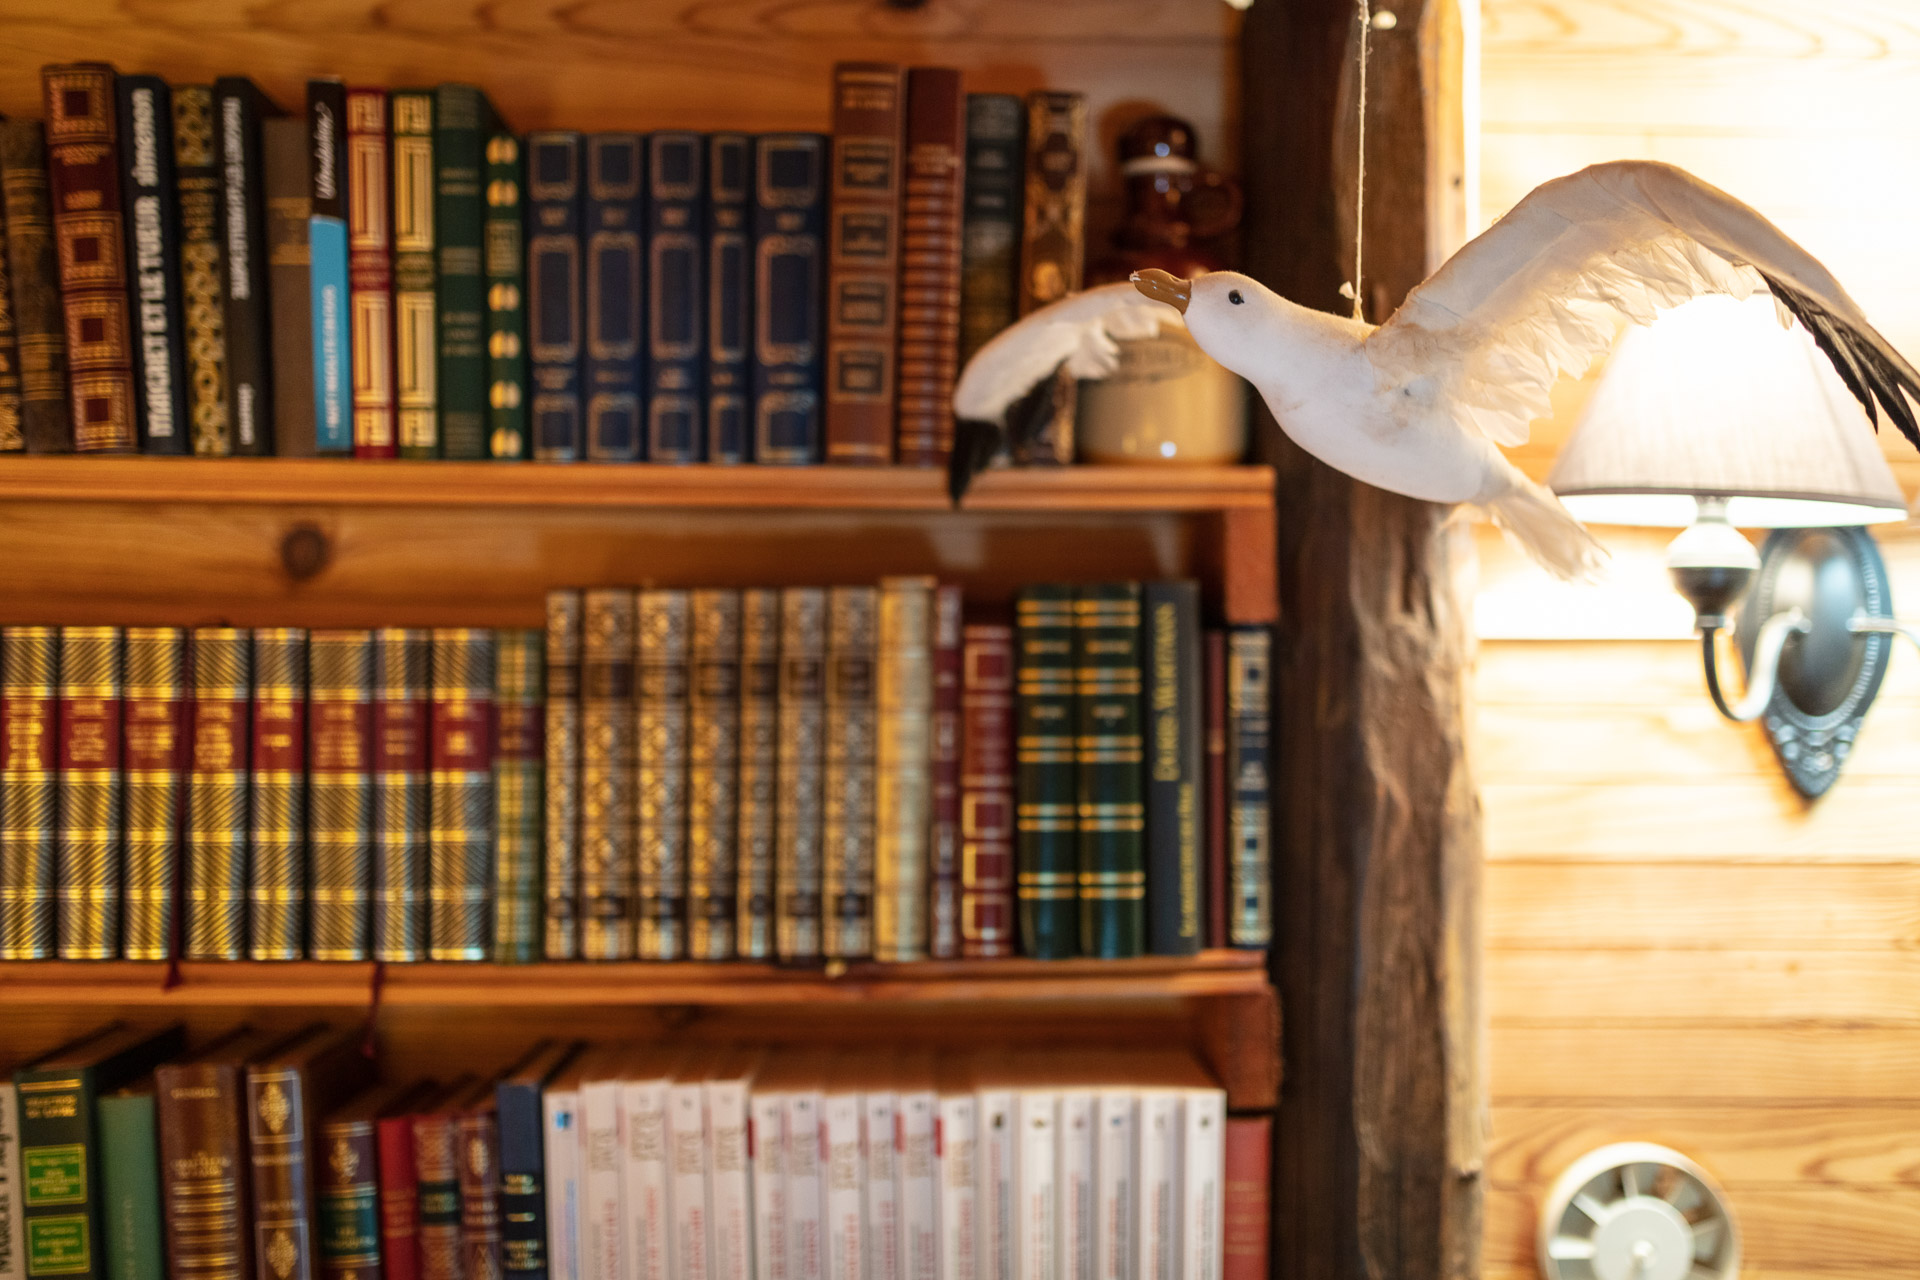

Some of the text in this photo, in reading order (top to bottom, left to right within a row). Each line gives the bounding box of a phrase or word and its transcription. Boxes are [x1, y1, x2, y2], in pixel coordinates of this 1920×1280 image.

[131, 88, 158, 187] simenon
[138, 272, 166, 301] LE
[140, 303, 167, 333] ET
[142, 336, 173, 437] MAIGRET
